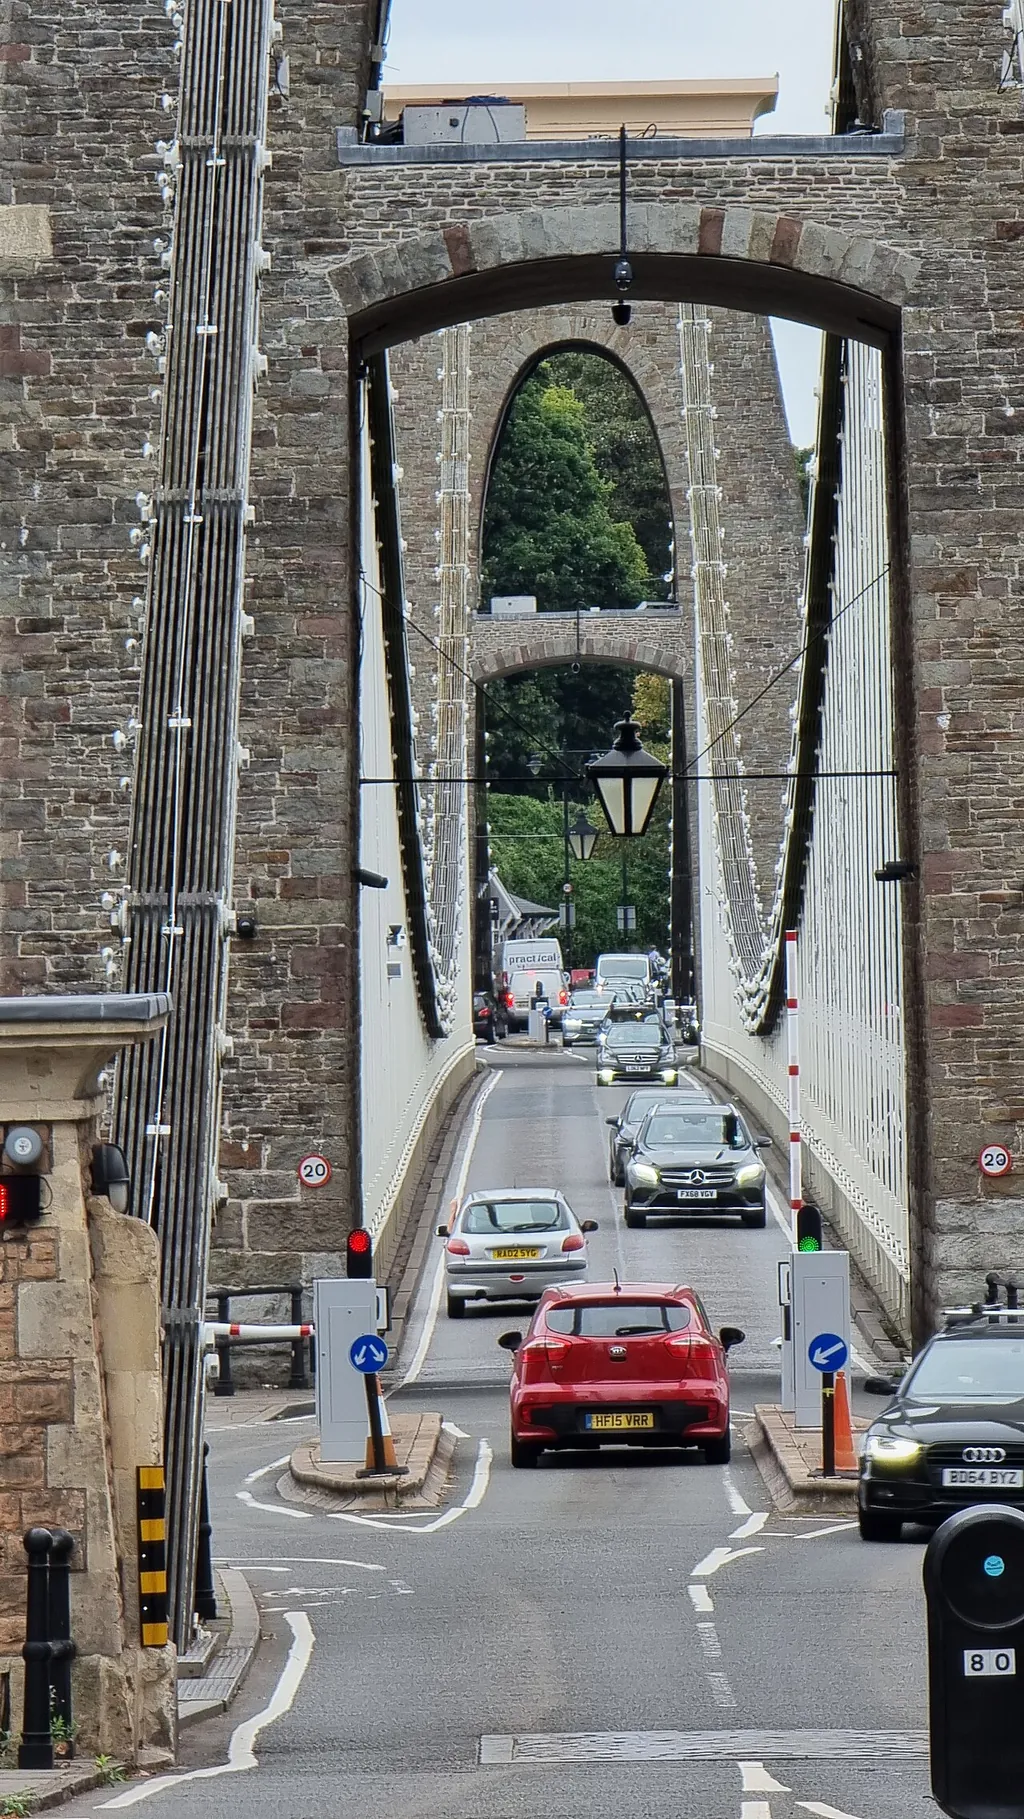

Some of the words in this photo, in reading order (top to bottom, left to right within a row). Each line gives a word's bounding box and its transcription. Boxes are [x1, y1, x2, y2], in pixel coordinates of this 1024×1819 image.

[509, 953, 556, 965] practical
[984, 1153, 1006, 1166] 20
[303, 1163, 326, 1177] 20
[680, 1190, 698, 1198] FX68
[520, 1249, 536, 1257] SYG
[595, 1415, 623, 1427] HF15
[625, 1415, 649, 1426] VRR
[950, 1470, 986, 1484] BD64
[990, 1471, 1018, 1485] BYZ
